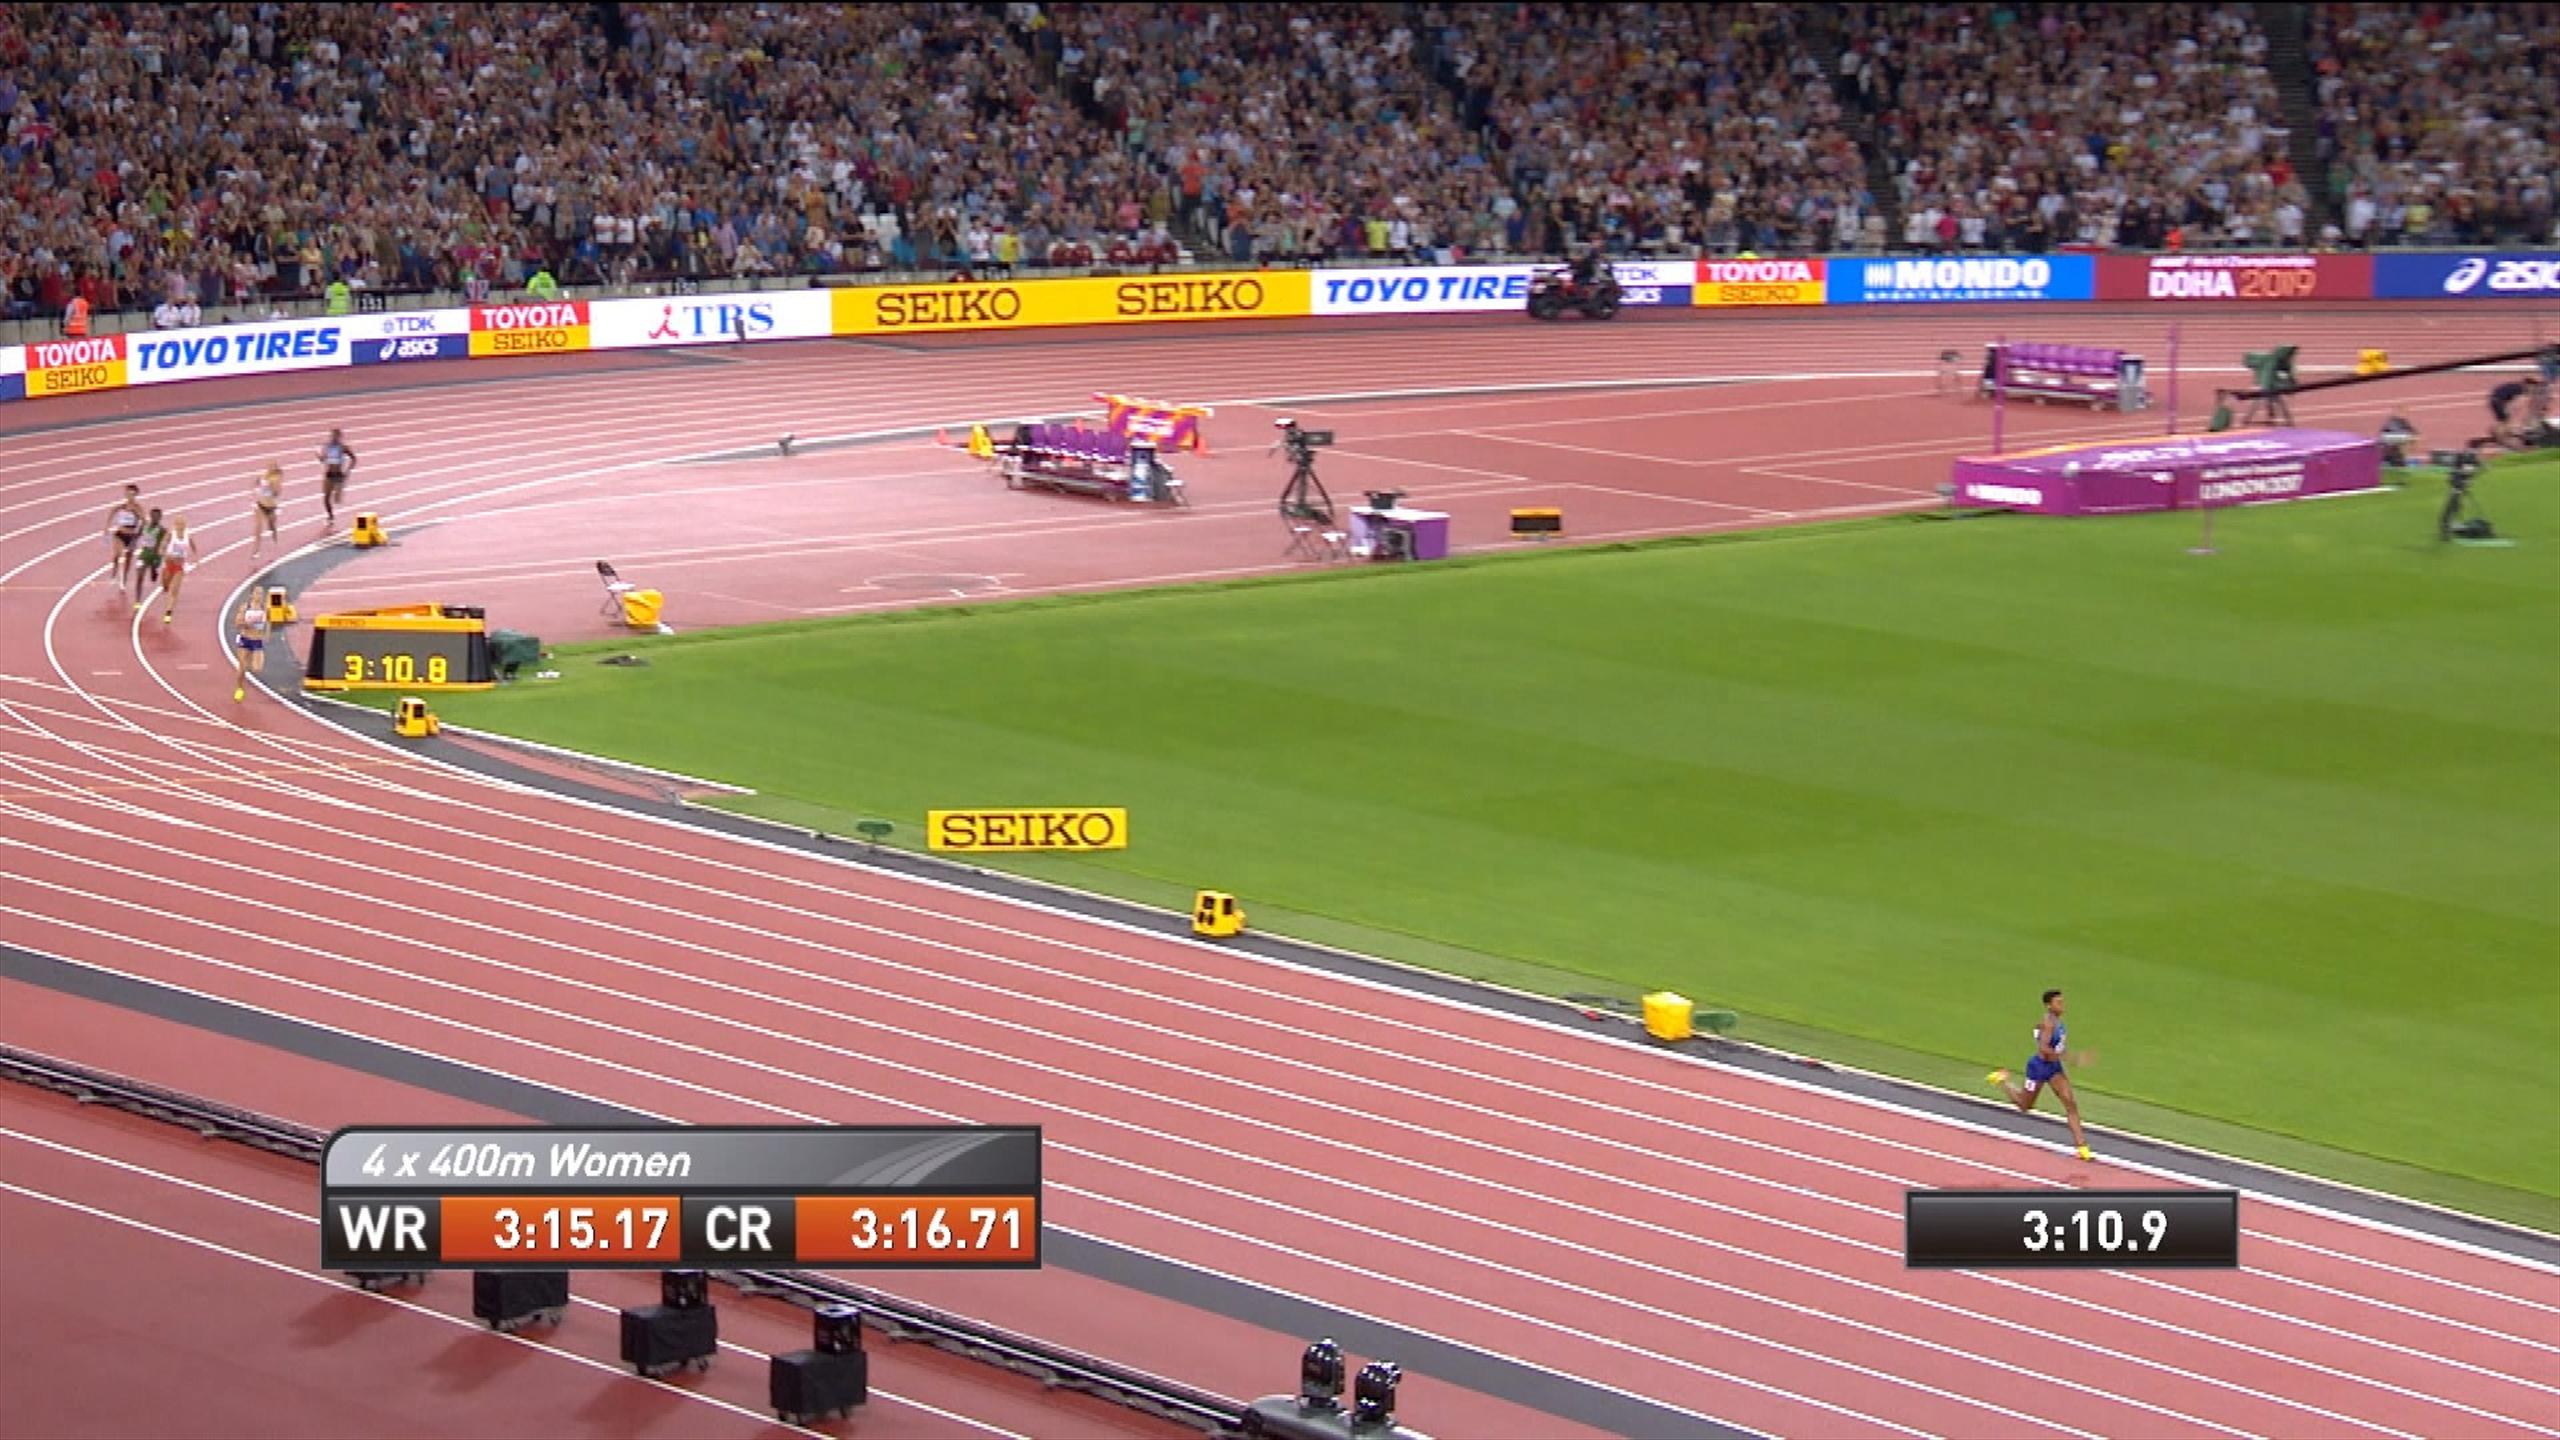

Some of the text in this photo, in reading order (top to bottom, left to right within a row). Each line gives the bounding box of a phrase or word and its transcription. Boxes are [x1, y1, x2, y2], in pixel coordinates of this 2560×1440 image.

[1706, 262, 1813, 282] TOYOTA
[1895, 259, 2051, 290] MONDO
[2149, 269, 2317, 297] DOHA 2019
[1117, 279, 1263, 315] SEIKO
[1326, 275, 1528, 303] TOYO TIRE
[1720, 285, 1799, 302] SEIKO
[481, 305, 578, 329] TOYOTA
[876, 287, 1020, 326] SEIKO
[397, 315, 436, 331] TDK
[35, 338, 117, 367] TOYOTA
[137, 327, 341, 371] TOYO TIRES
[397, 338, 439, 357] asics
[494, 331, 567, 350] SEIKO
[45, 366, 108, 390] SEIKO
[344, 655, 447, 683] 3:10.8
[941, 813, 1114, 846] SEIKO
